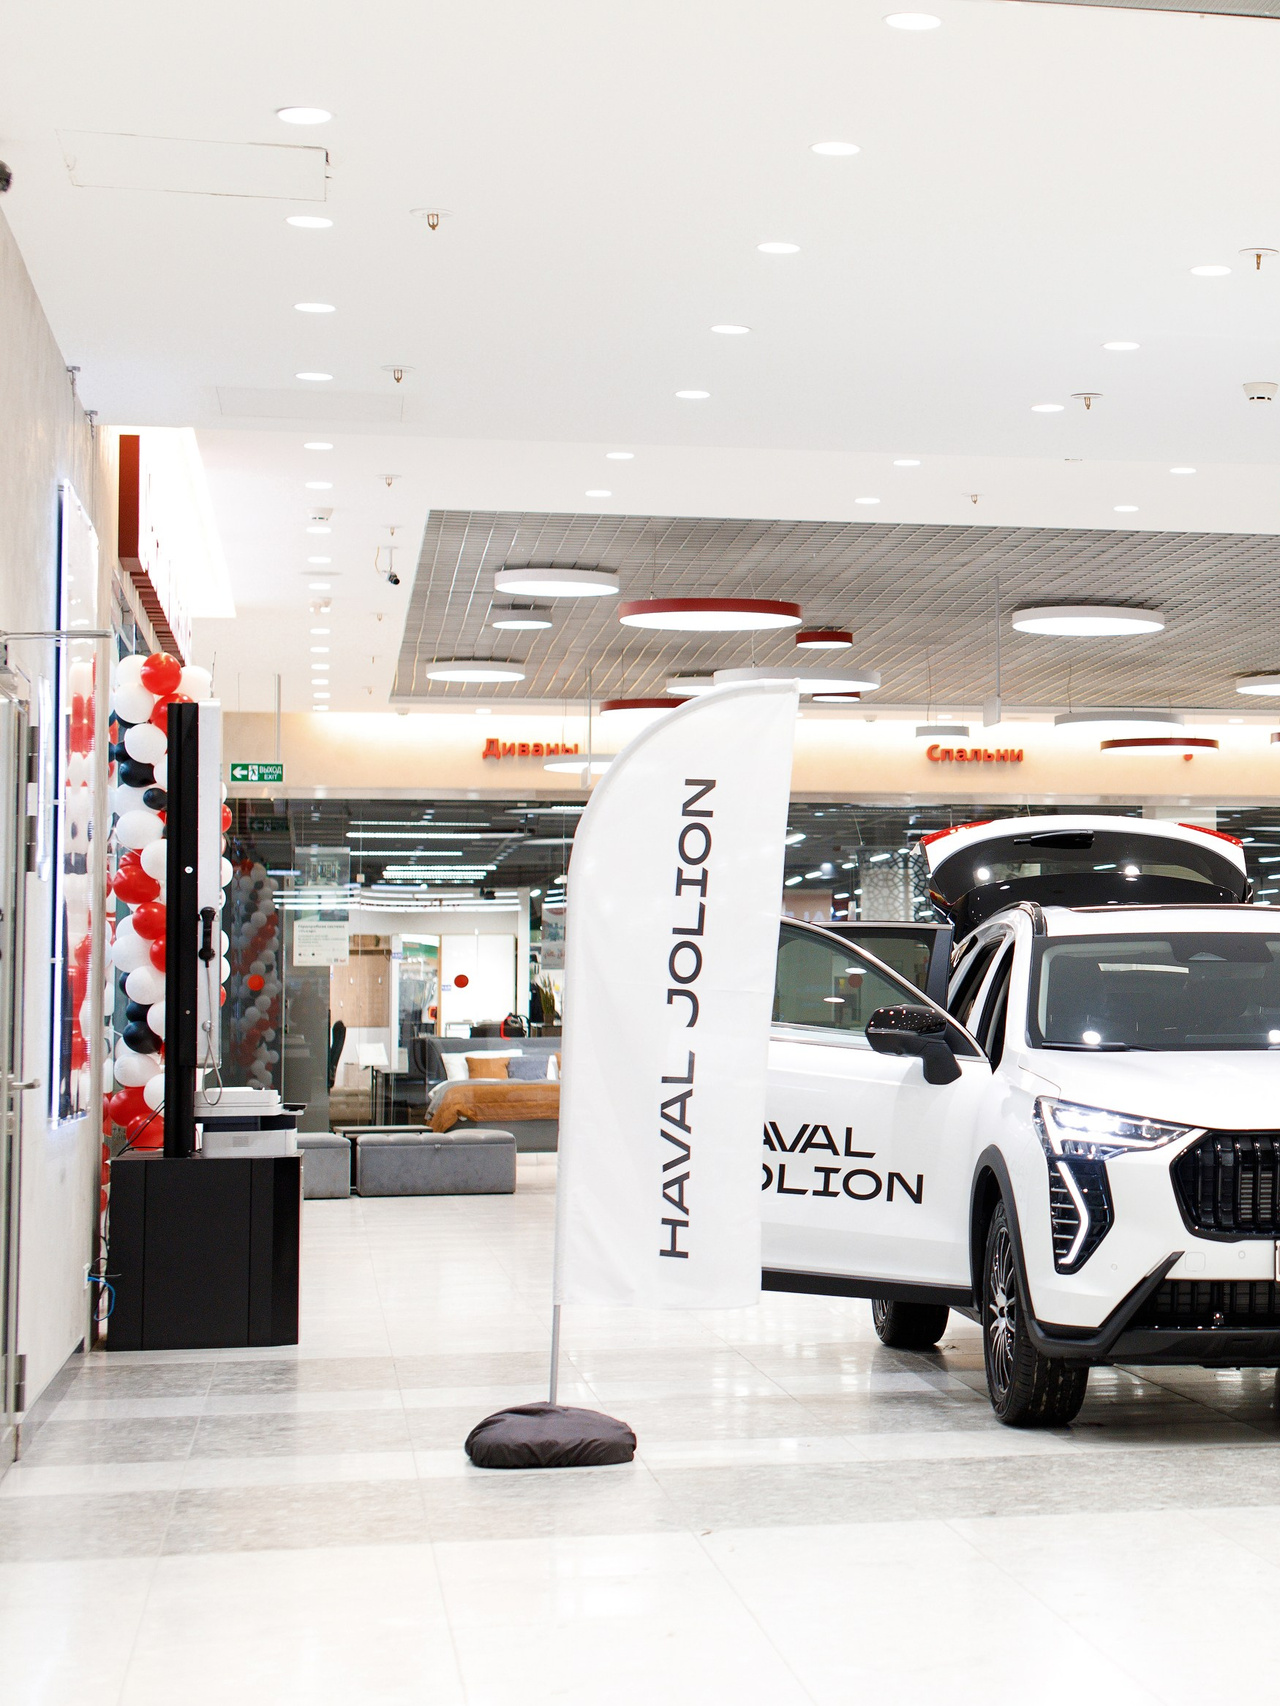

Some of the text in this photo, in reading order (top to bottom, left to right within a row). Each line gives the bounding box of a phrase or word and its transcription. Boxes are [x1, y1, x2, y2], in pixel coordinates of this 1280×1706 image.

[482, 738, 579, 760] Диваны
[926, 744, 1024, 763] Спальни
[658, 778, 717, 1259] HAVAL JOLION
[763, 1121, 877, 1158] VAL
[761, 1163, 924, 1204] LION
